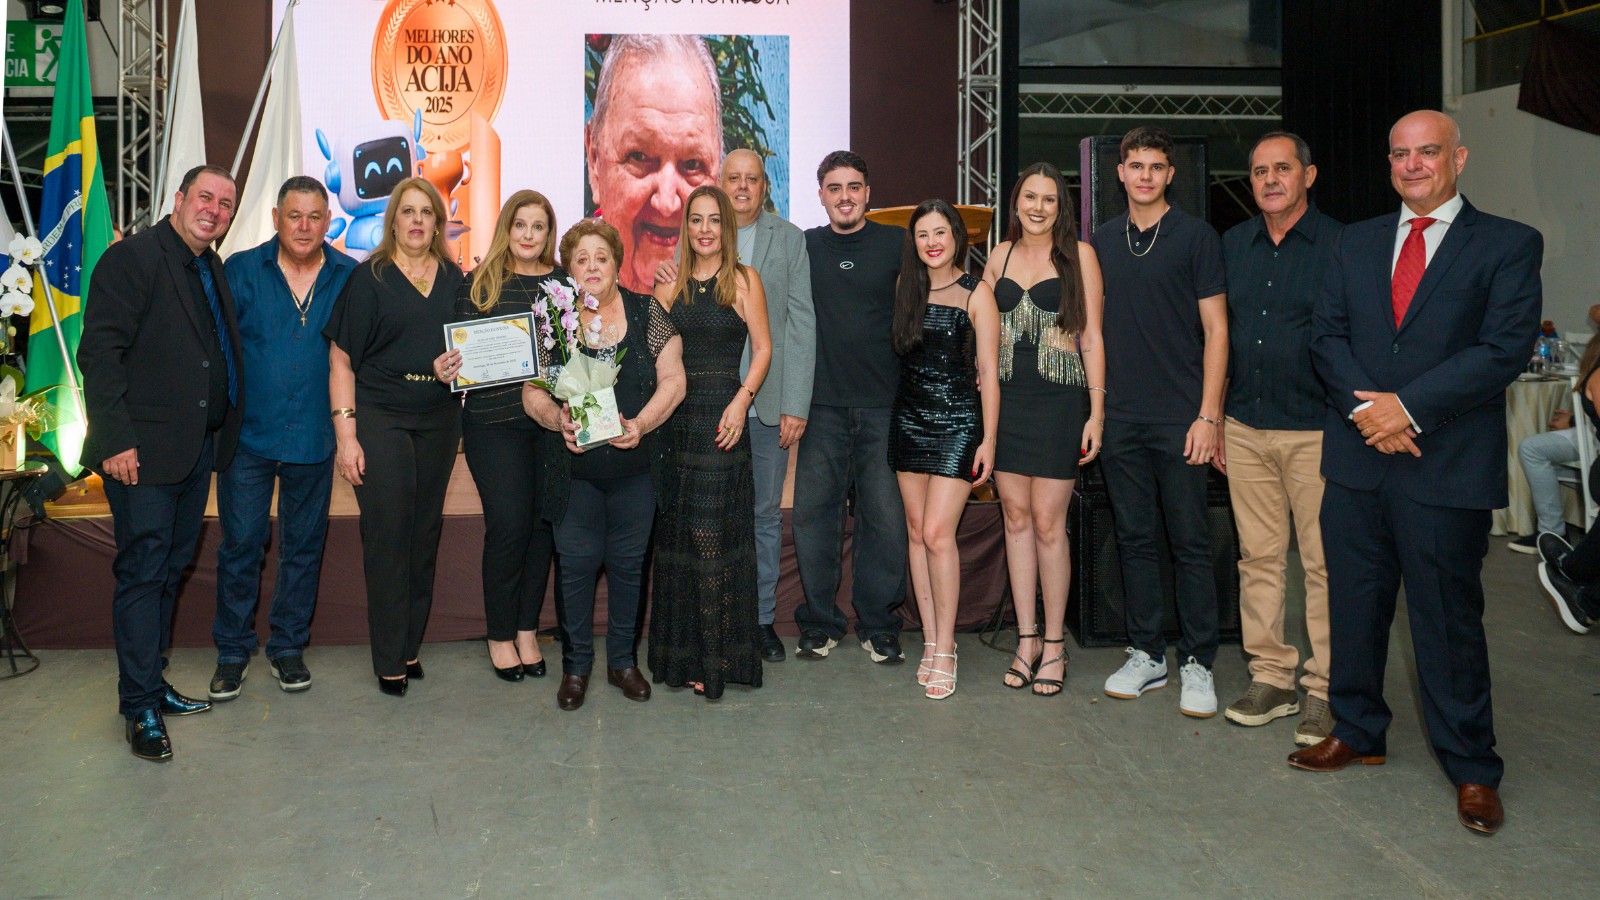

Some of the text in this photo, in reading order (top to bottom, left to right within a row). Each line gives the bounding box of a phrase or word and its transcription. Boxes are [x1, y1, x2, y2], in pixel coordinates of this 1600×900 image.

[405, 29, 474, 44] MELHORES
[407, 45, 473, 65] DO ANO
[404, 65, 474, 92] ACIJA
[425, 96, 453, 113] 2025
